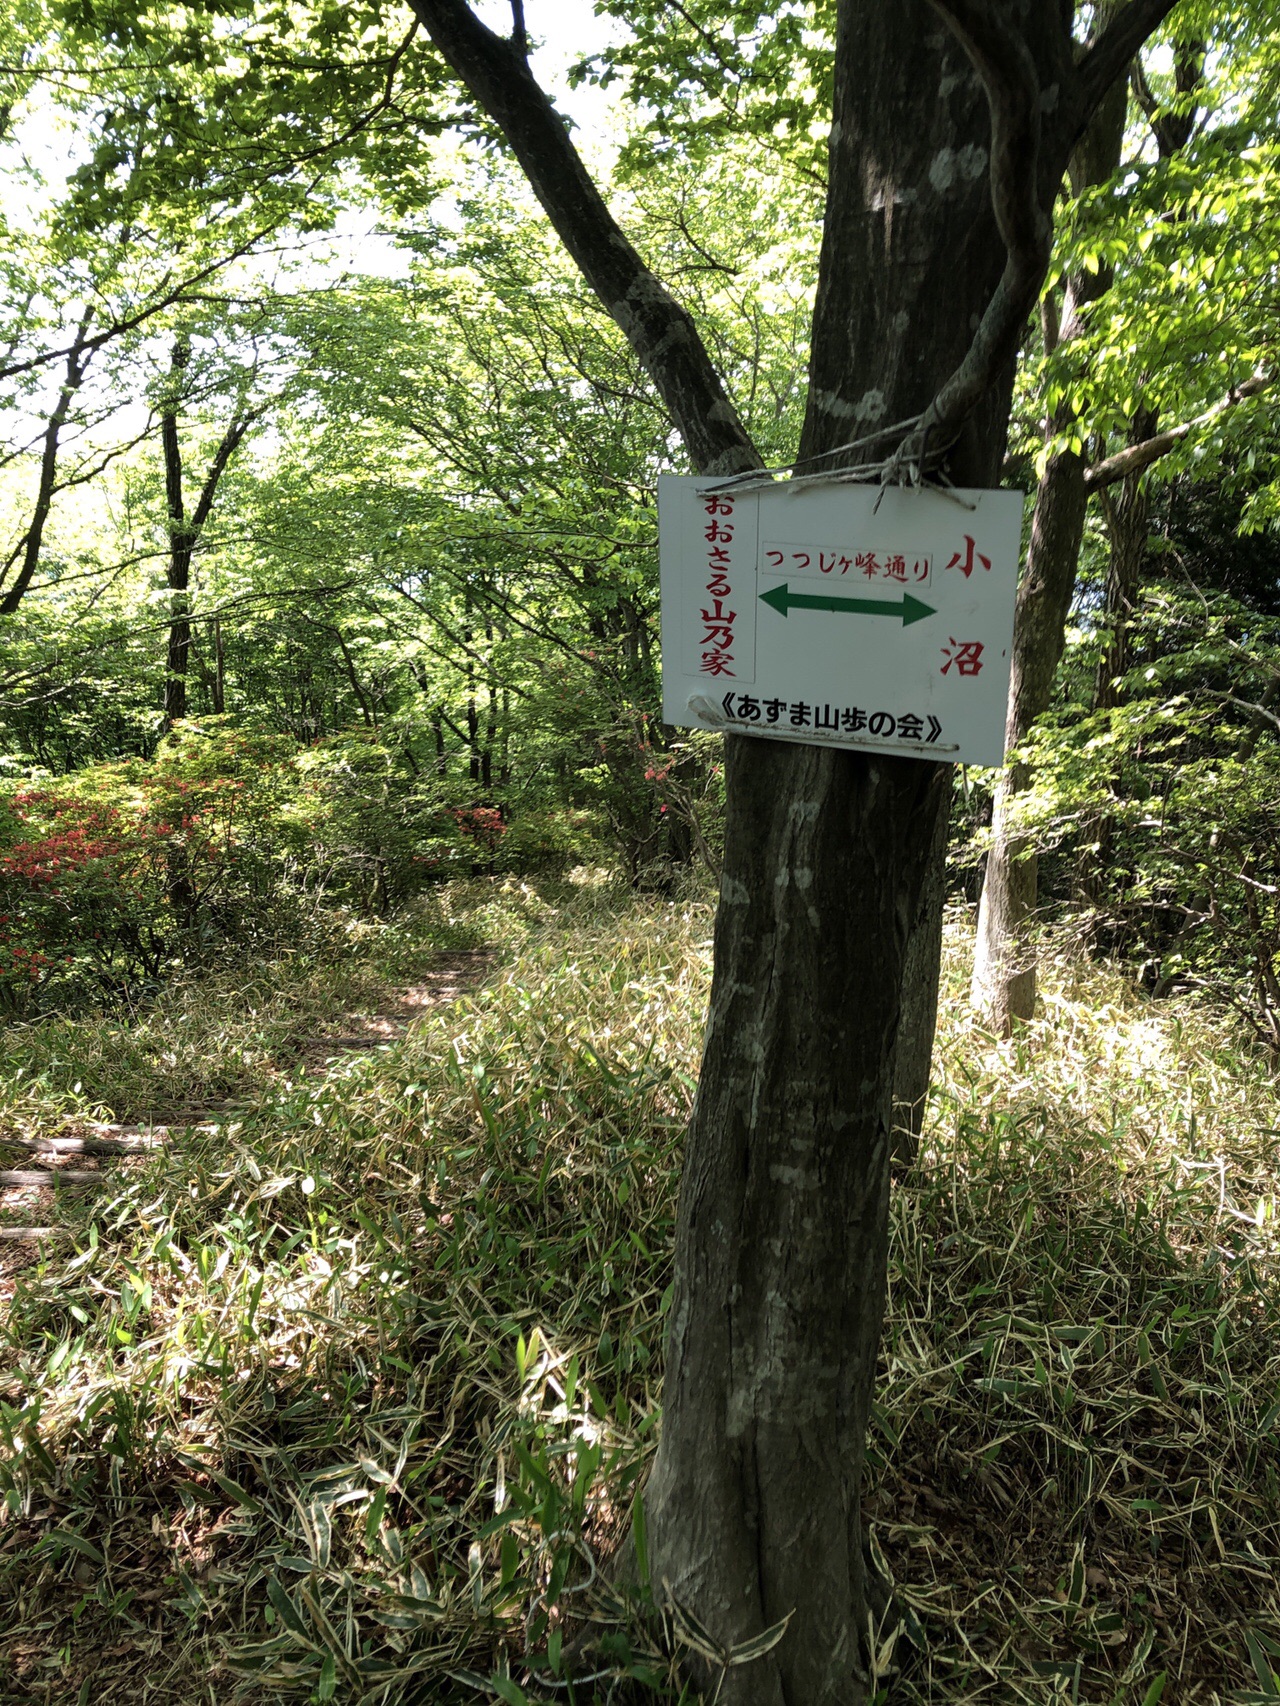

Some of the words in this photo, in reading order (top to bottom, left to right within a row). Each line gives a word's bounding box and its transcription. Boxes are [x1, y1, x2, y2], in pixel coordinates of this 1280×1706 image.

[699, 495, 737, 677] おおさる山乃家
[940, 534, 992, 676] 小沼
